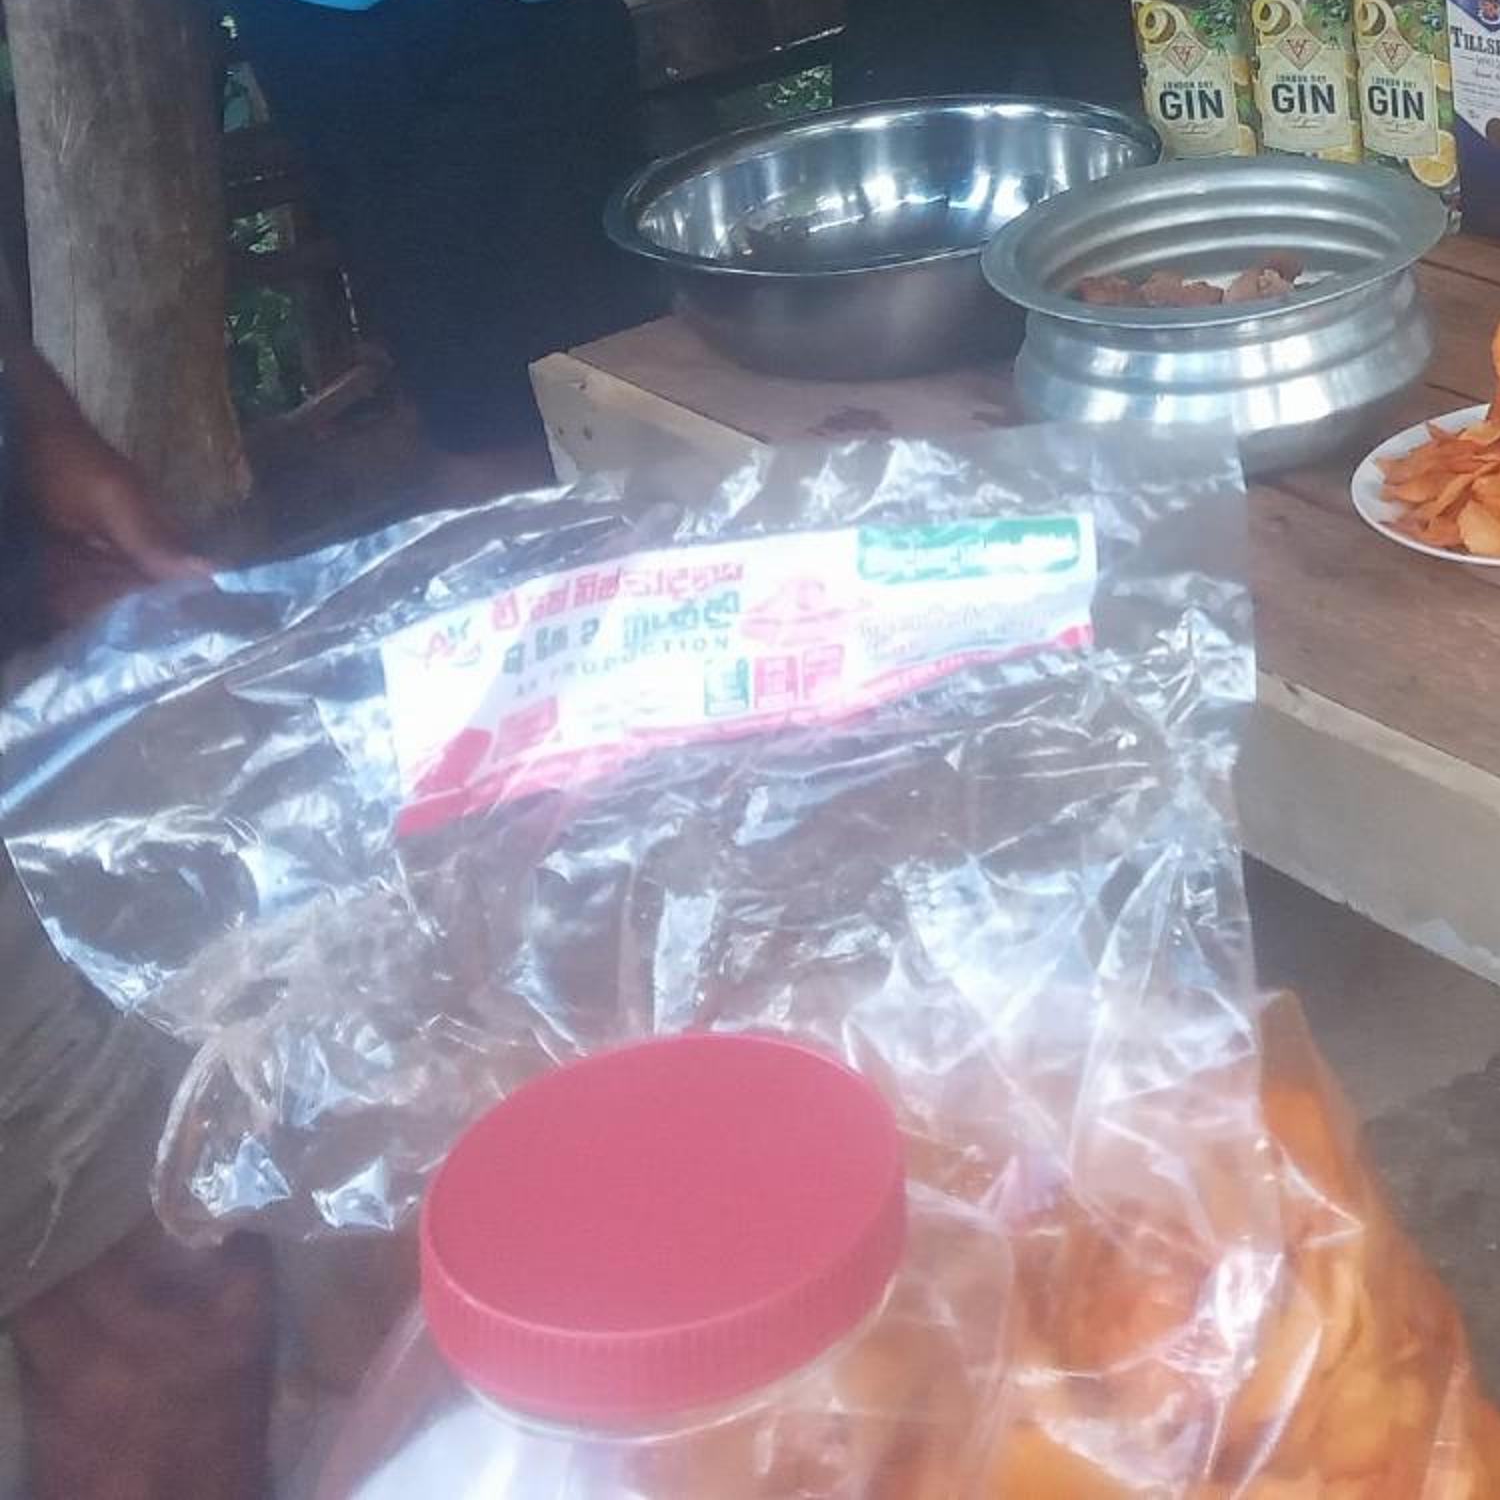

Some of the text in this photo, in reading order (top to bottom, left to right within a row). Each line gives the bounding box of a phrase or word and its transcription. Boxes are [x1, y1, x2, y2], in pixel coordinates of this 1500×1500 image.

[1159, 89, 1225, 120] GIN
[1271, 83, 1336, 114] GIN
[1367, 85, 1425, 121] GIN
